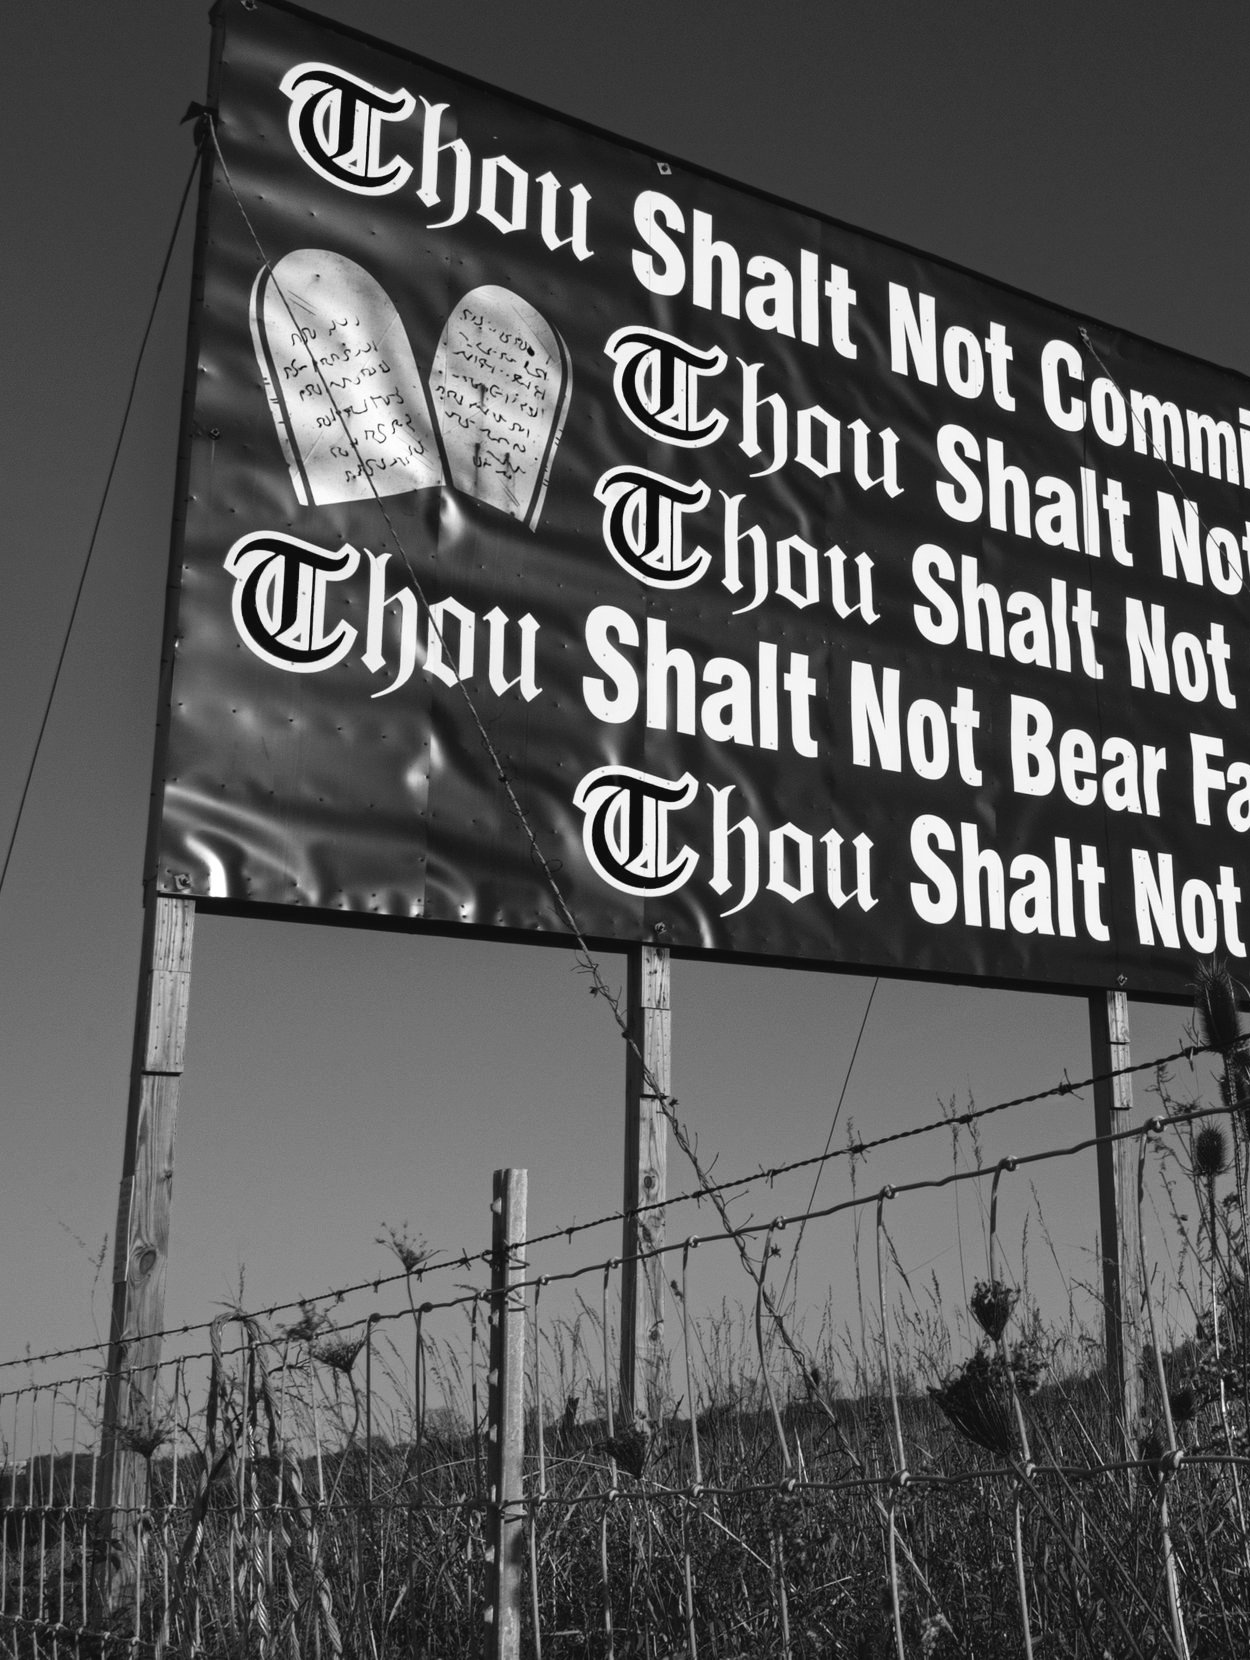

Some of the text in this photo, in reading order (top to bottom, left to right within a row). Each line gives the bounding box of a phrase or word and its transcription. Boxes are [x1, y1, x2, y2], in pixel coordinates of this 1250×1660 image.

[279, 62, 594, 261] Thou
[632, 191, 857, 359] Shalt
[889, 282, 1015, 411] Not
[604, 326, 904, 498] Thou
[936, 424, 1133, 566] Shalt
[223, 531, 542, 702] Thou
[582, 606, 817, 757] Shalt
[851, 661, 982, 786] Not
[1011, 695, 1166, 818] Bear
[594, 465, 880, 624] Thou
[912, 544, 1103, 679] Shalt
[1126, 597, 1236, 709] Not
[574, 765, 878, 918] Thou
[911, 815, 1110, 941] Shalt
[1132, 849, 1246, 957] Not
